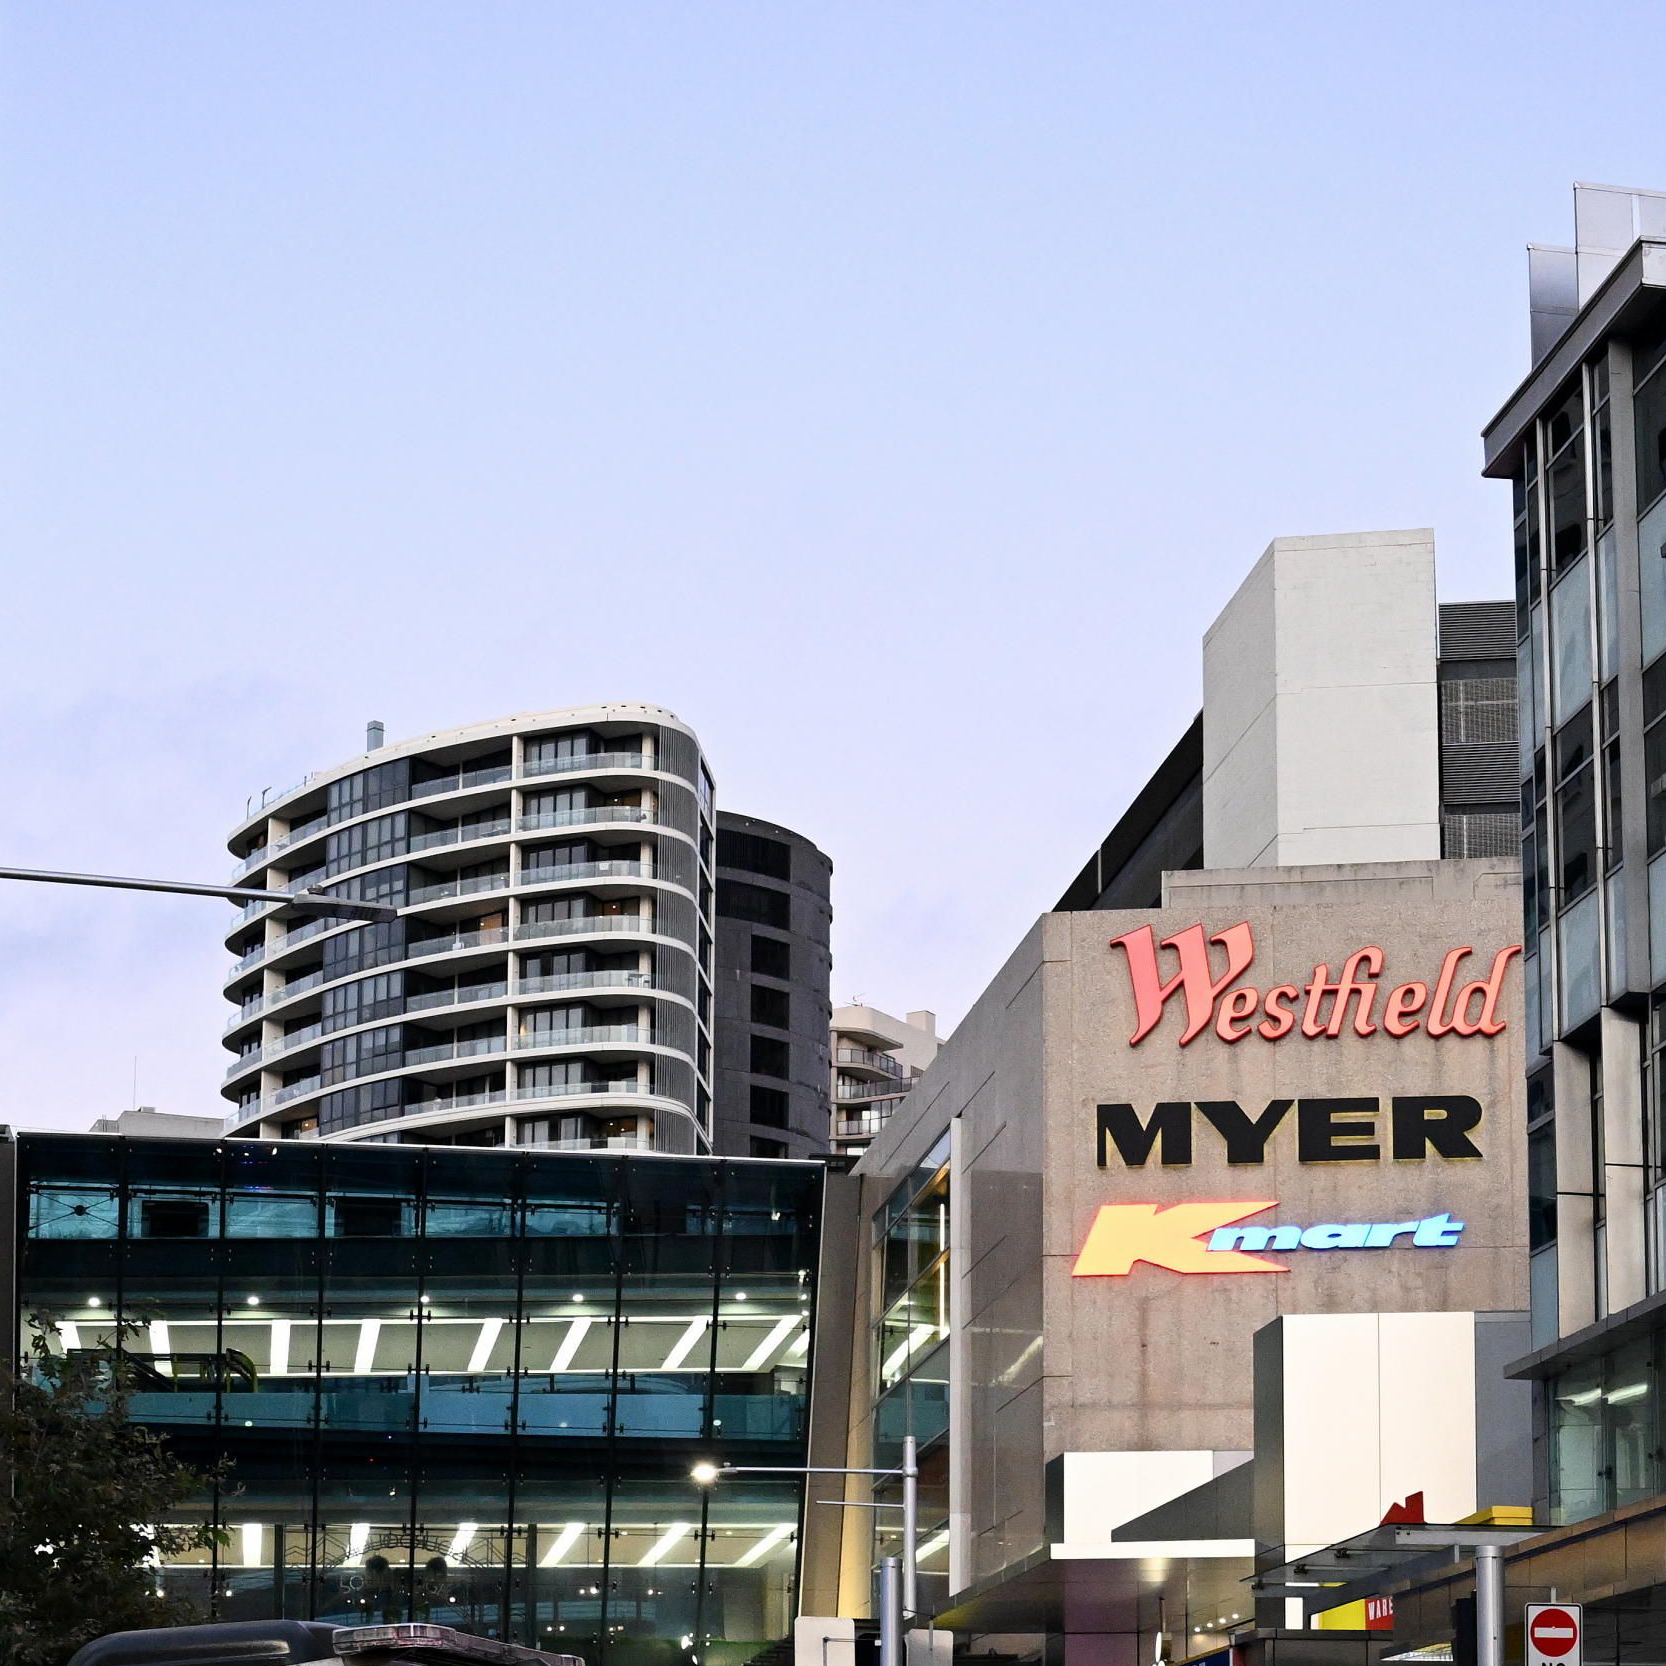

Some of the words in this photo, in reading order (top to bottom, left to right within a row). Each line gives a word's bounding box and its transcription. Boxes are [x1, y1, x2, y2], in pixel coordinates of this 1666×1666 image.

[1109, 921, 1523, 1048] Westfield
[1096, 1094, 1484, 1168] MYER
[1071, 1200, 1467, 1277] Kmart
